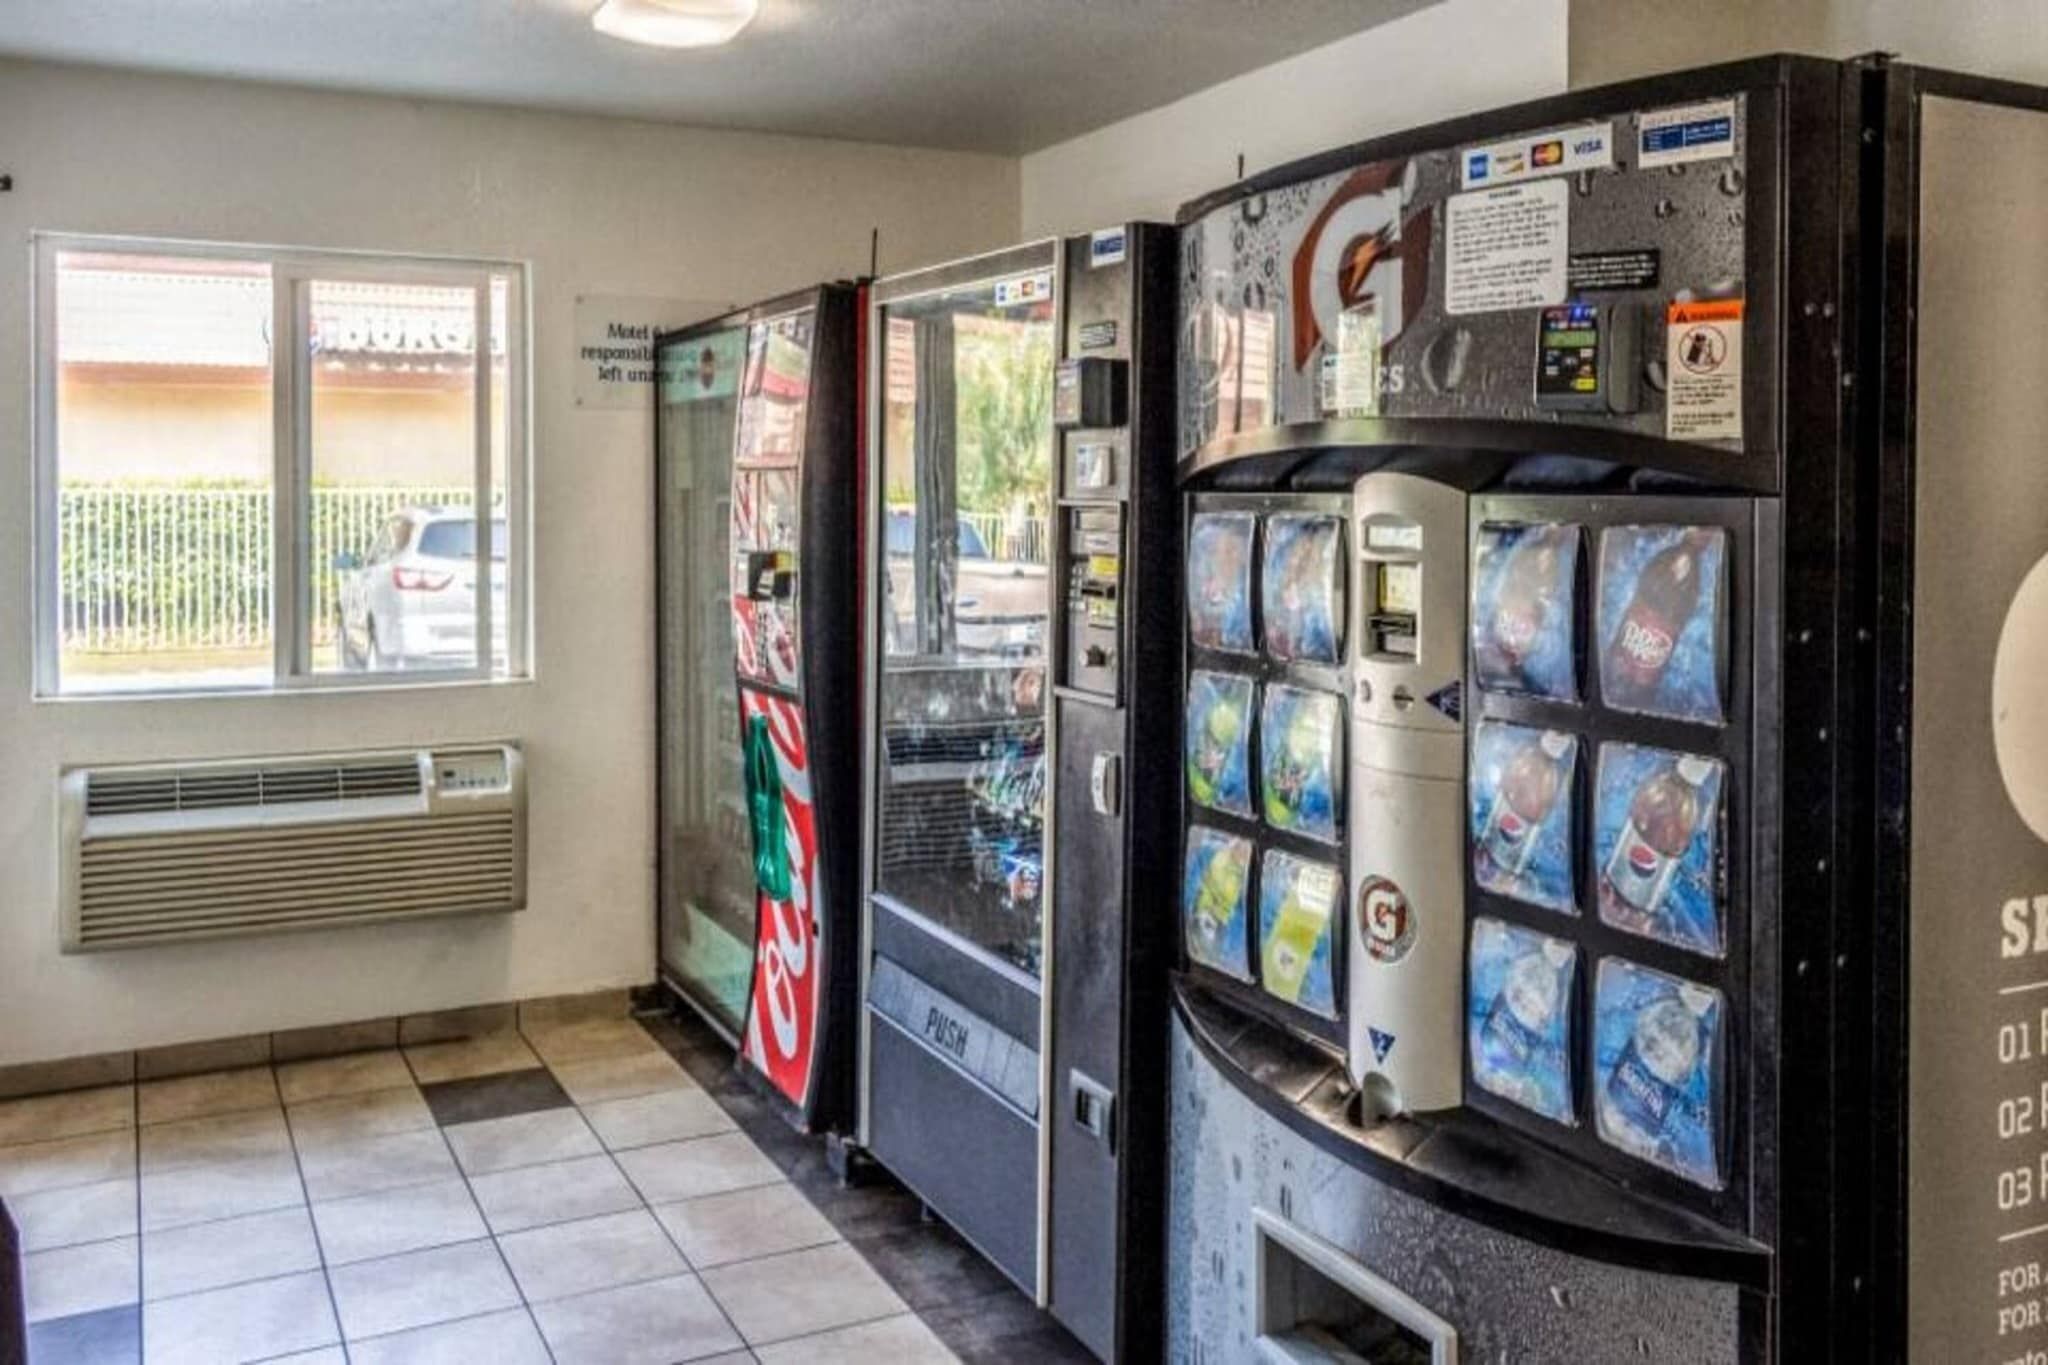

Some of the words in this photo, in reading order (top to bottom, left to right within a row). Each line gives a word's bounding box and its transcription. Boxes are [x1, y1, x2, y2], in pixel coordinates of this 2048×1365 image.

[1573, 139, 1603, 156] VISA
[608, 323, 649, 340] Motel
[599, 366, 622, 381] left
[1366, 889, 1398, 941] G
[925, 1007, 969, 1058] PUSH
[1998, 1022, 2032, 1064] 01
[1998, 1096, 2033, 1139] 02
[1998, 1167, 2032, 1210] 03
[1998, 1262, 2041, 1296] FOR
[1998, 1300, 2041, 1335] FOR
